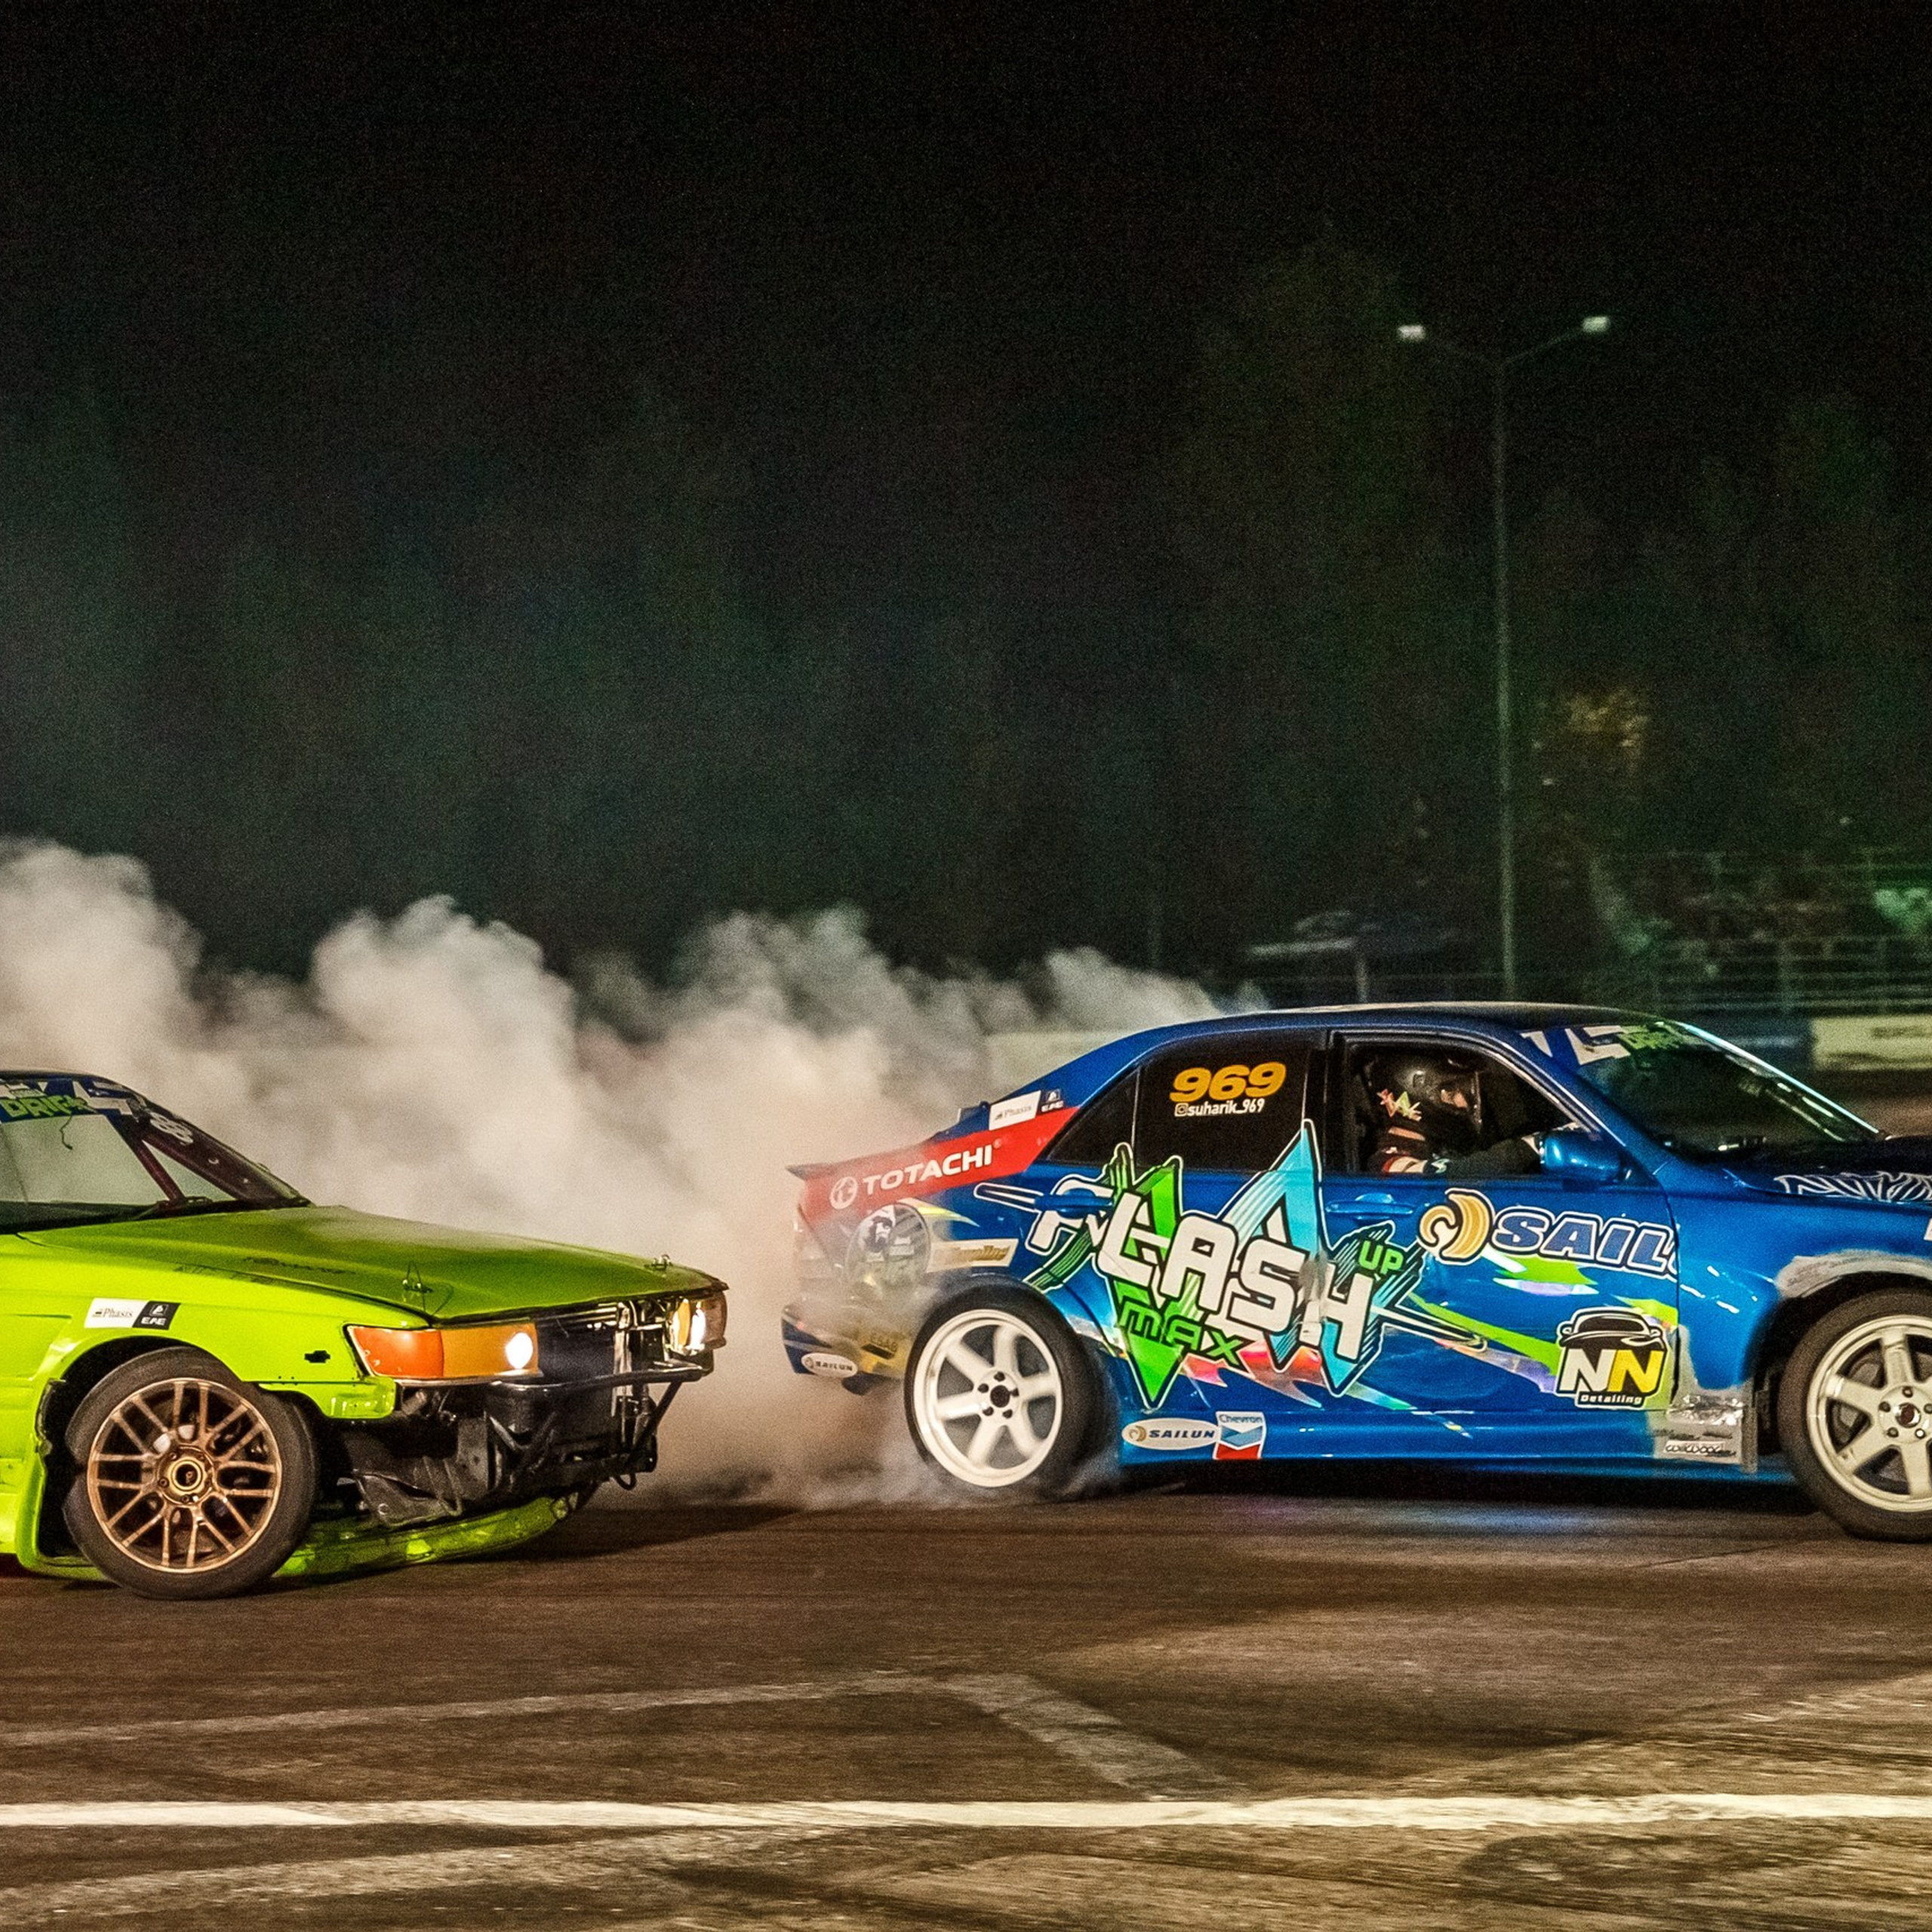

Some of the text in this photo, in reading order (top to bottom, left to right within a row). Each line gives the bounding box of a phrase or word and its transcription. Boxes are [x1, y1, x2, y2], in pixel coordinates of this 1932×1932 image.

[1170, 1061, 1287, 1102] 969
[863, 1144, 993, 1195] TOTACHI
[1358, 1239, 1404, 1275] UP
[1491, 1205, 1678, 1277] SAIL
[1557, 1348, 1665, 1394] NN
[1149, 1429, 1215, 1439] SAILUN
[1218, 1414, 1263, 1424] Chevron
